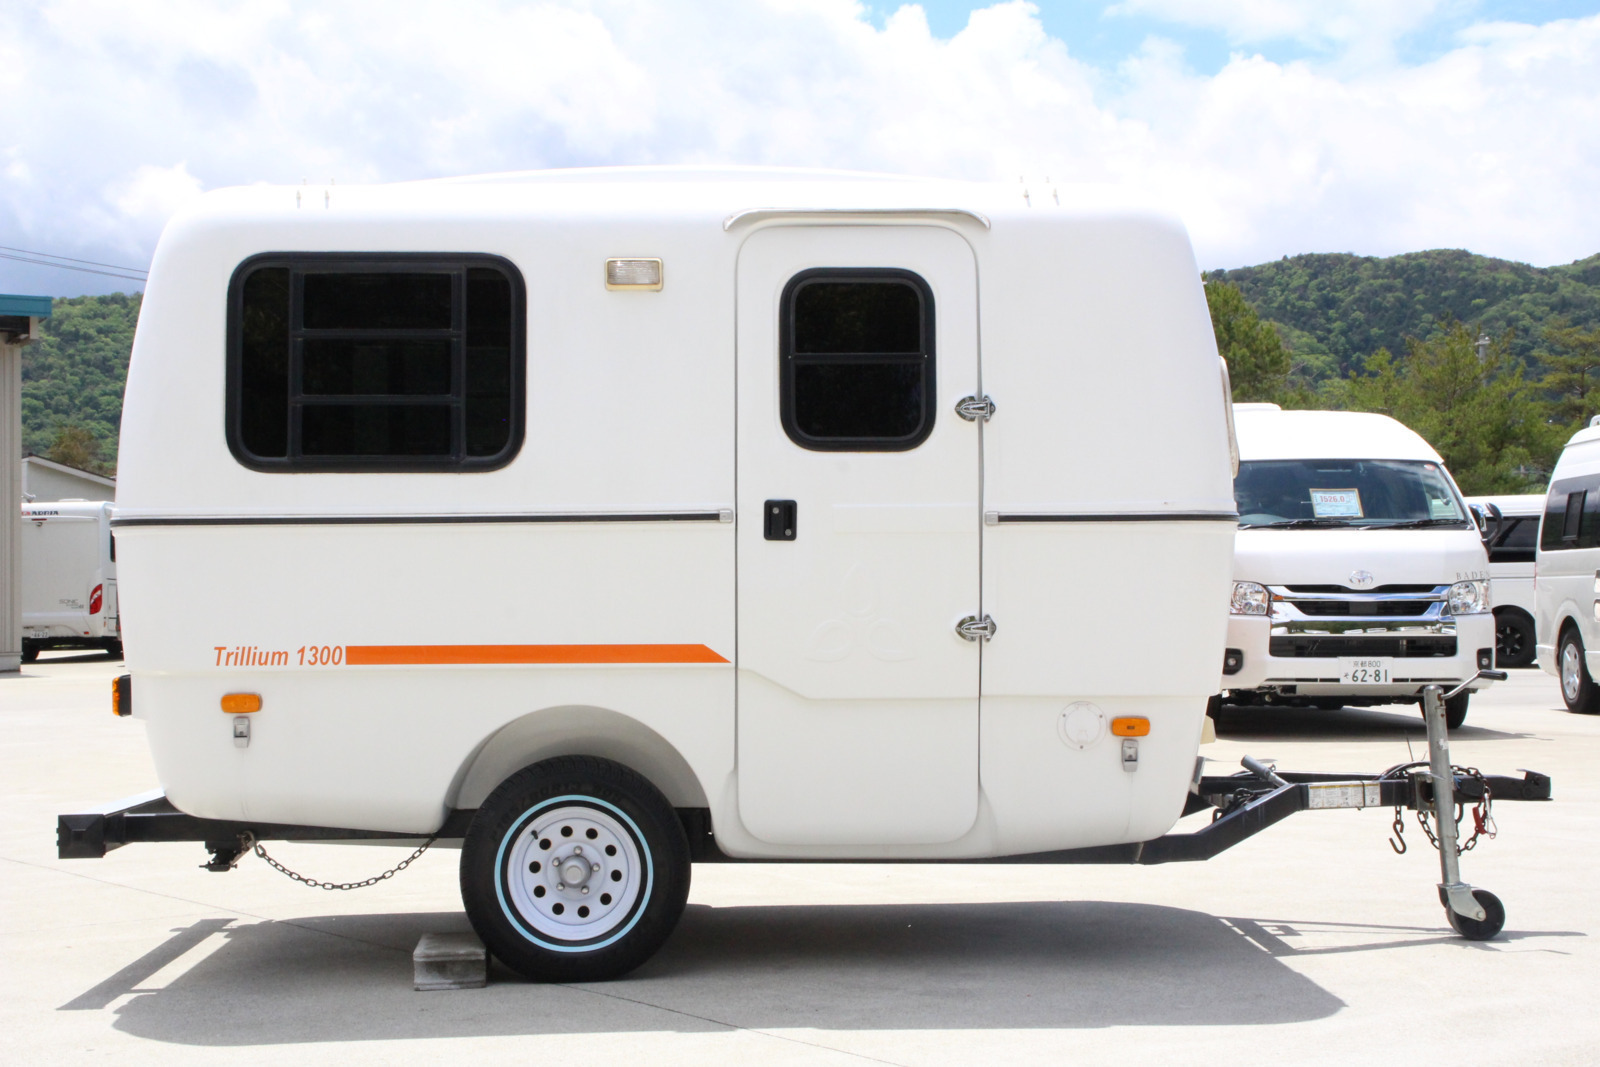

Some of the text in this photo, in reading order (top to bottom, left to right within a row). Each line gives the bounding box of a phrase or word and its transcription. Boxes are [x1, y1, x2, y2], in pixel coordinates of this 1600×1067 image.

[213, 645, 343, 667] Trillium 1300
[1352, 669, 1388, 682] 62-81
